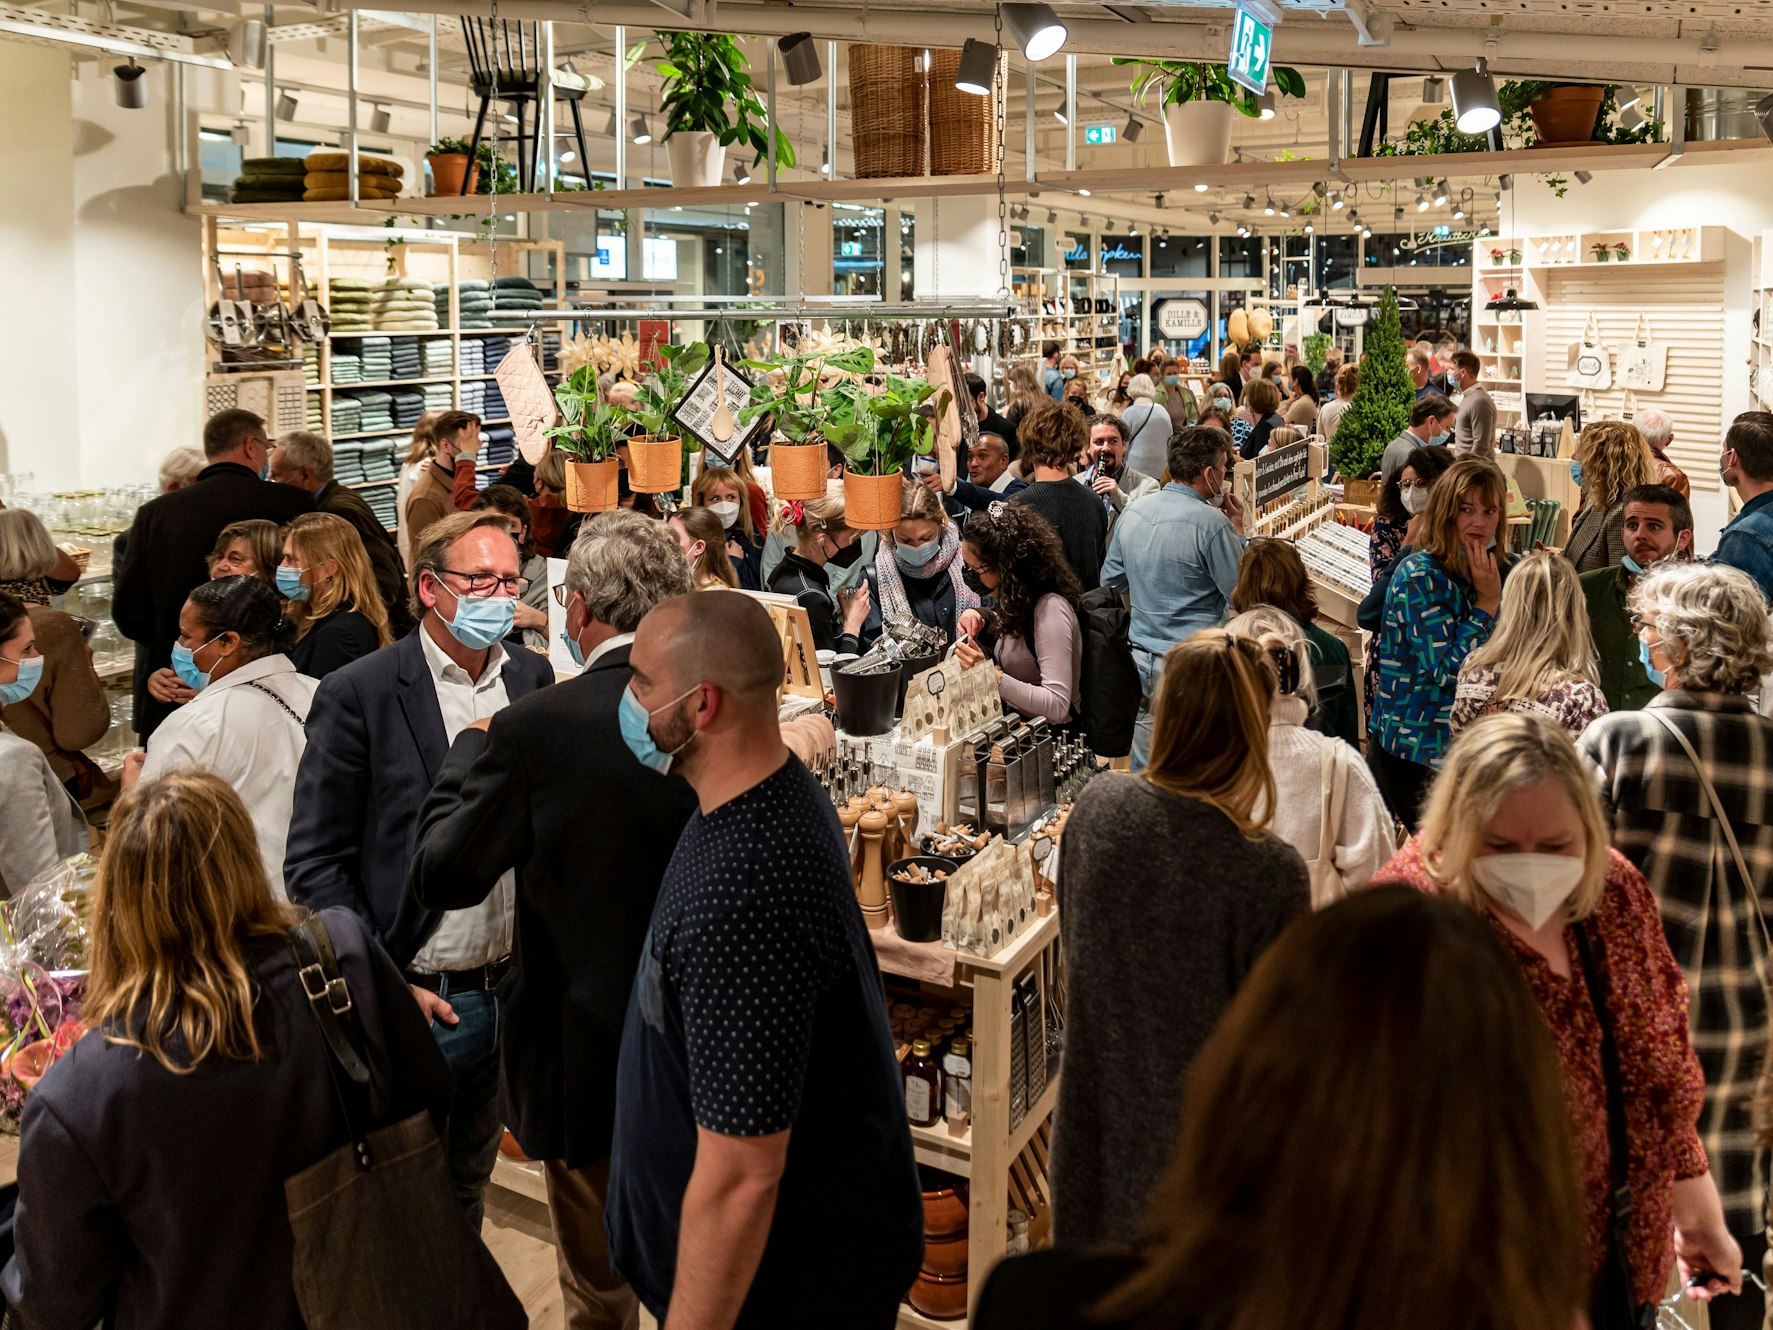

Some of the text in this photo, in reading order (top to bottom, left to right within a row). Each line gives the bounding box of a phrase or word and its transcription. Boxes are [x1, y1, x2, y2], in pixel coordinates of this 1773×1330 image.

[1167, 310, 1200, 319] DILLE &
[1165, 319, 1202, 328] KAMILLE
